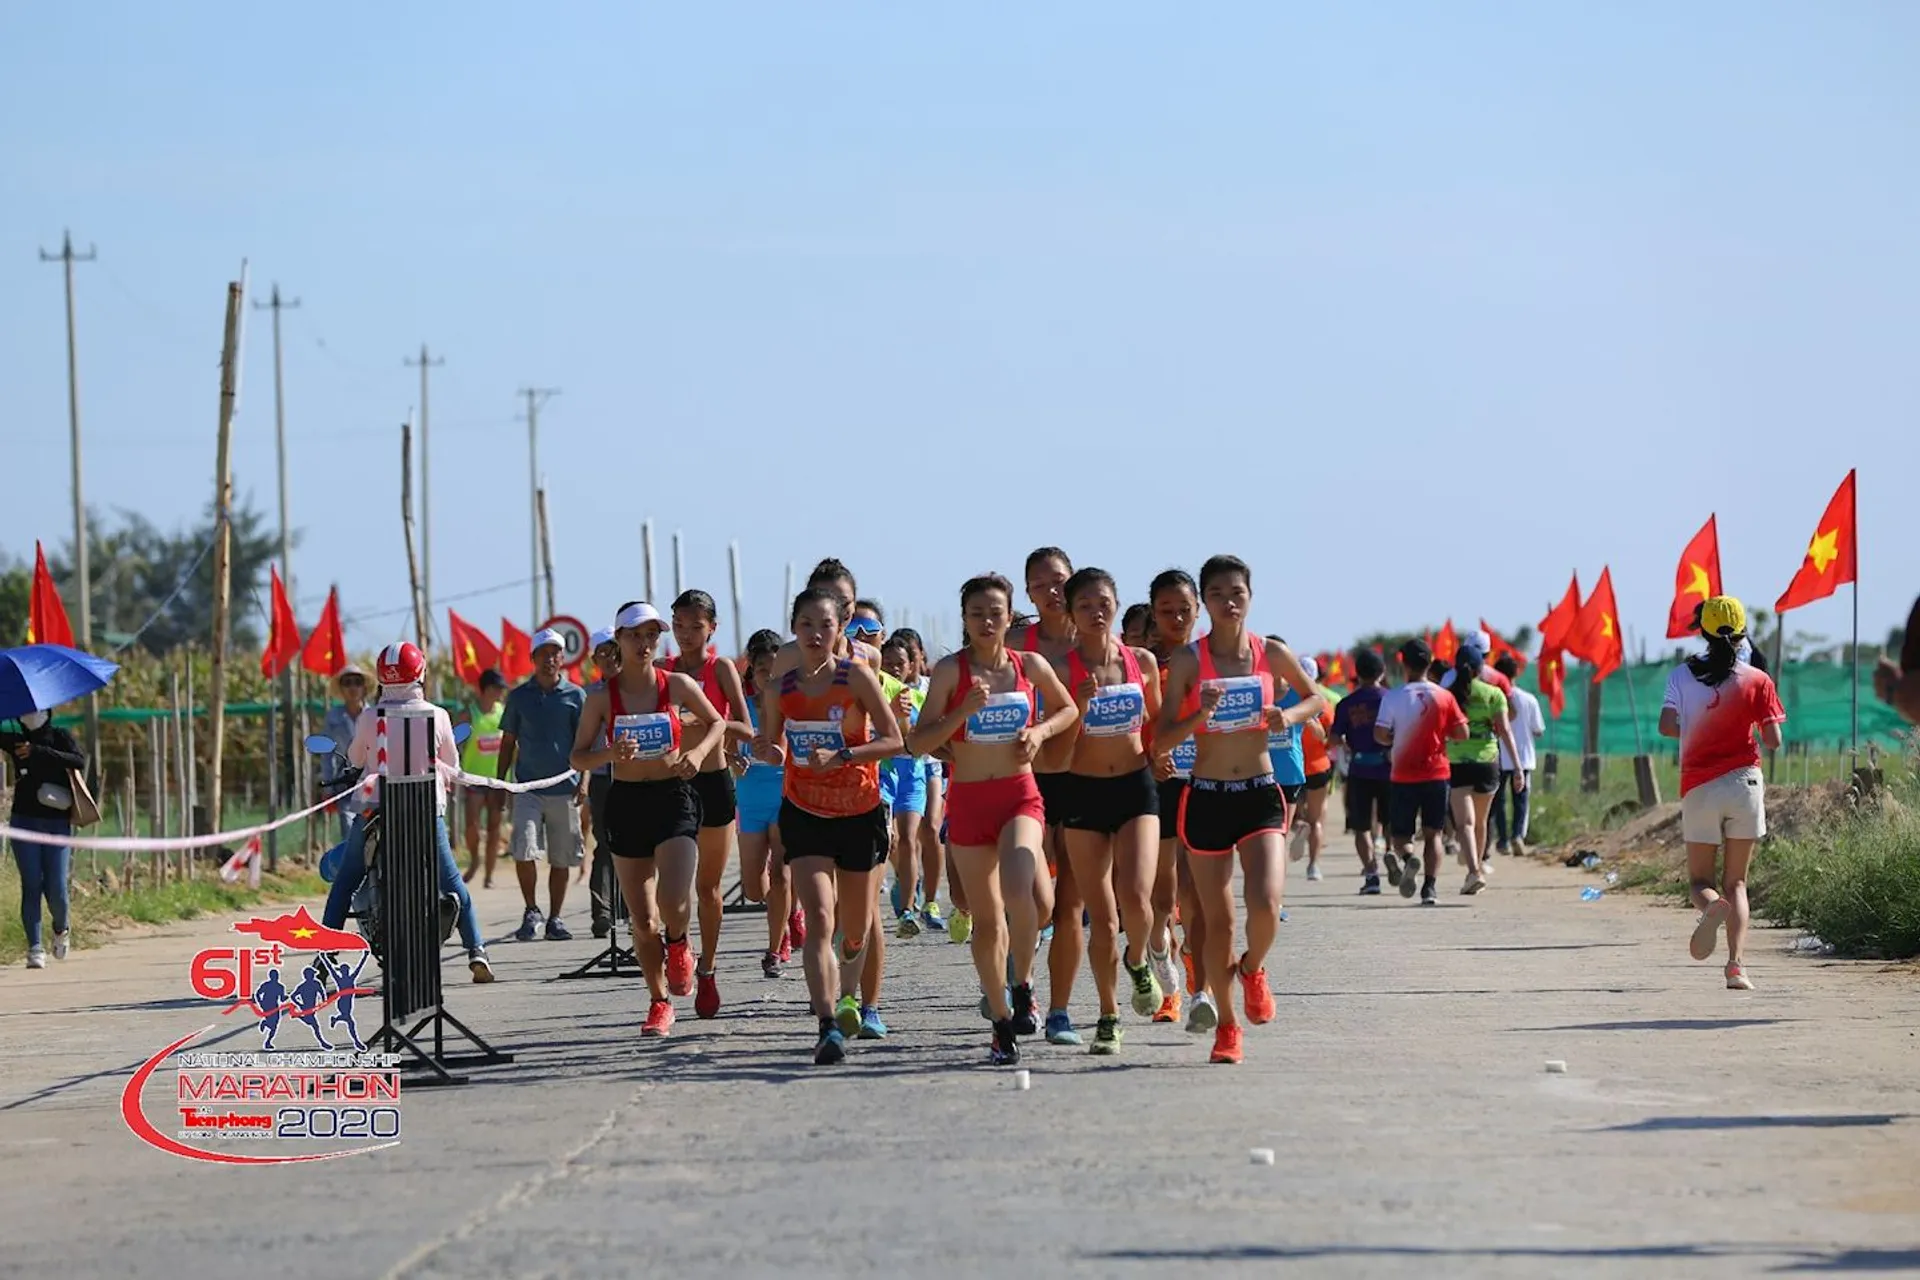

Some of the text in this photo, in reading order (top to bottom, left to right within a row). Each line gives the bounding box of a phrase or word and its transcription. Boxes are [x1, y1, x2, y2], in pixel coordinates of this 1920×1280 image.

[1090, 697, 1135, 716] Y5543
[1217, 691, 1255, 708] 5538
[976, 707, 1022, 724] Y5529
[790, 732, 836, 747] Y5534
[1193, 778, 1218, 792] PINK
[1223, 781, 1249, 793] PINK
